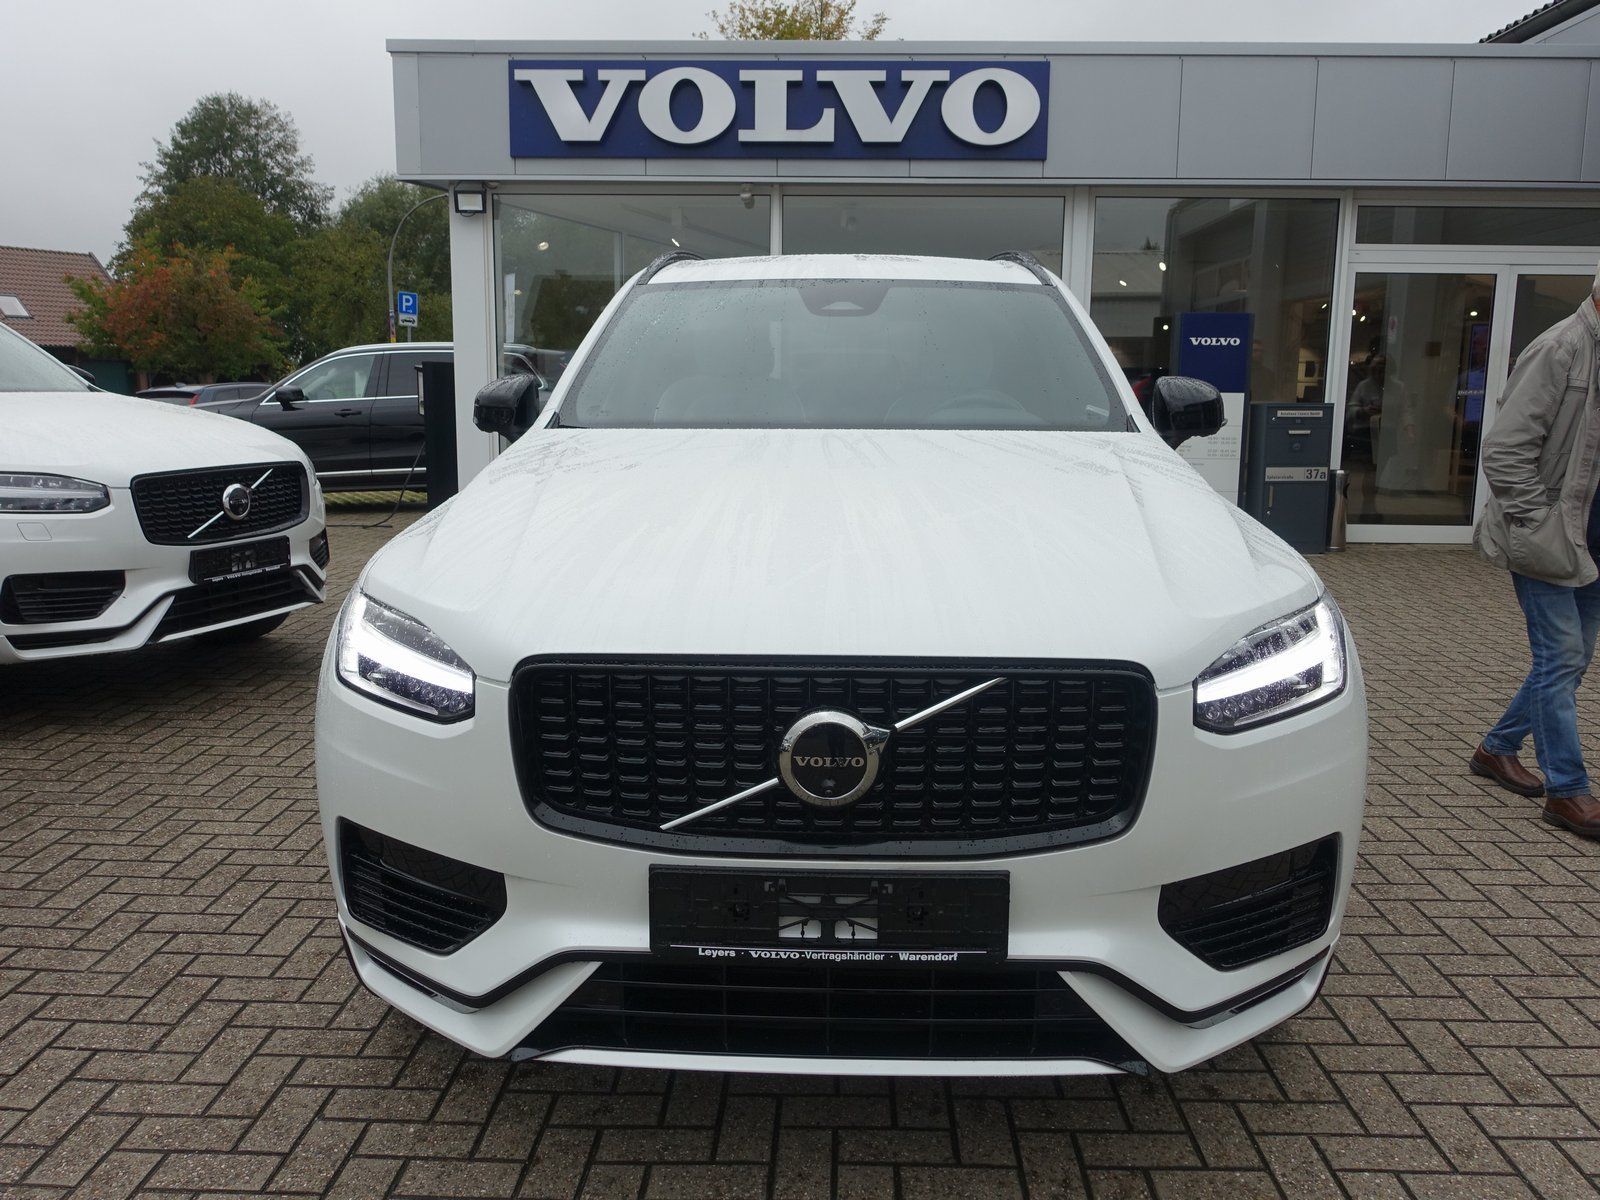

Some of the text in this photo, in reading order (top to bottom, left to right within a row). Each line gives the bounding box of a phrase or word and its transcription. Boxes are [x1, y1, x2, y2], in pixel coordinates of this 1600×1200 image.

[514, 66, 1041, 146] VOLVO
[402, 294, 413, 312] P
[1189, 337, 1241, 346] VOLVO
[1305, 468, 1327, 480] 37a
[793, 756, 865, 768] VOLVO
[698, 947, 736, 958] Leyers
[898, 952, 958, 961] Warendorf
